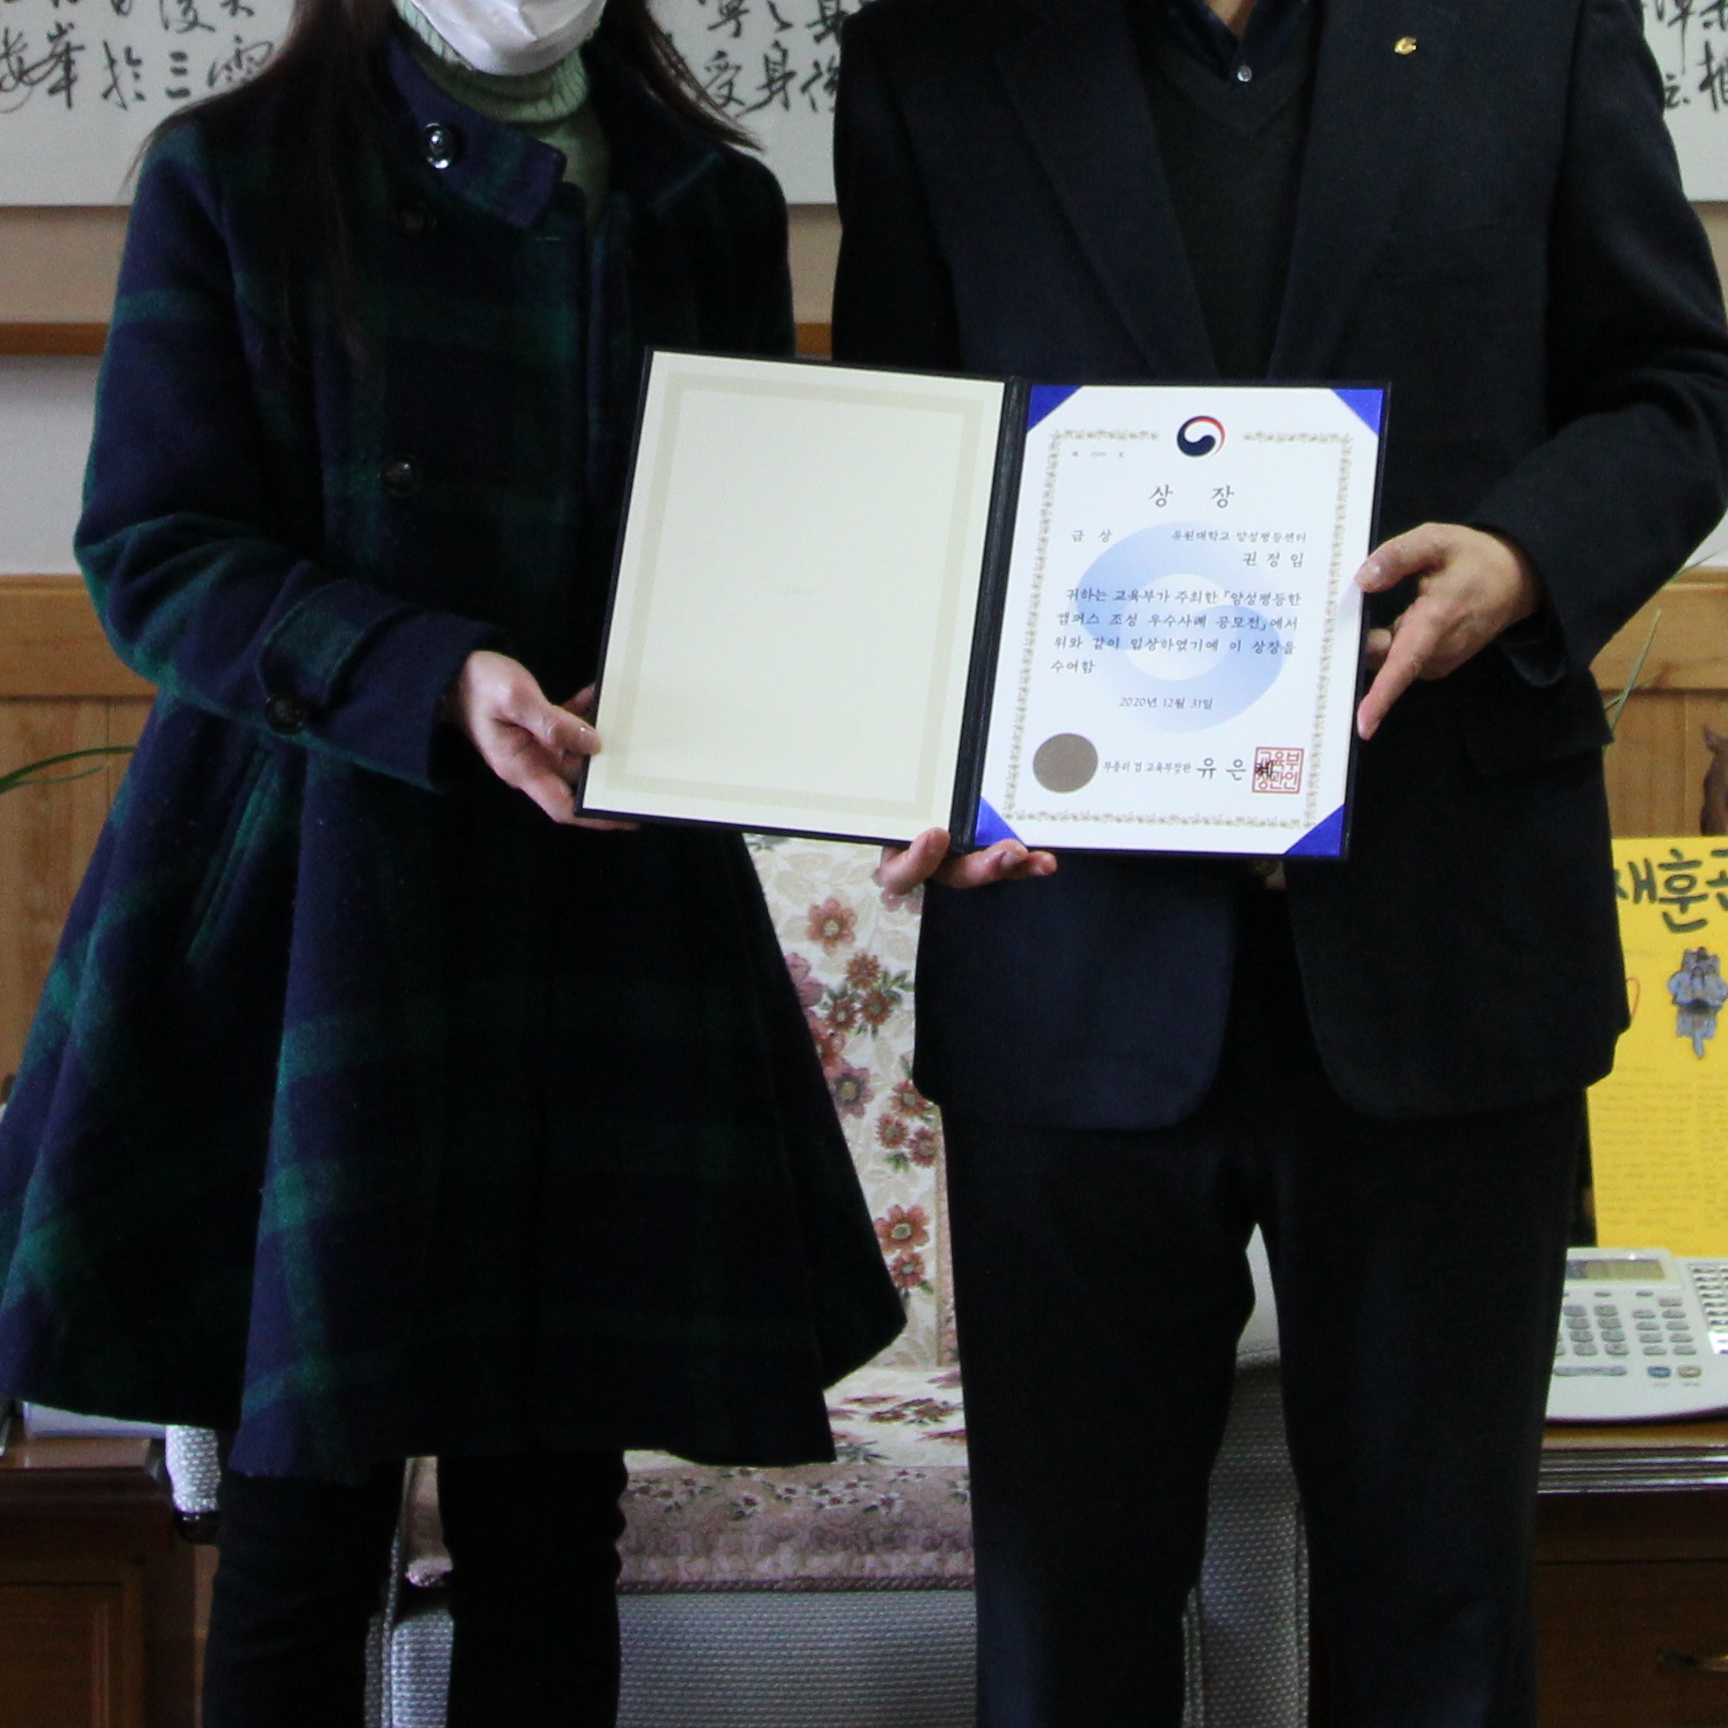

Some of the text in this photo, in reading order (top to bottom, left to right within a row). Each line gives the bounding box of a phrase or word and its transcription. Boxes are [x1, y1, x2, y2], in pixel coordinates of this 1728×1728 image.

[1066, 587, 1109, 602] 귀하는
[1113, 588, 1170, 604] 교육부가
[1175, 589, 1218, 605] 주최한
[1109, 612, 1139, 627] 조성
[1147, 613, 1208, 629] 우수사례
[1053, 635, 1297, 656] 위와 같이 입상하였기에 이 상장을
[1118, 696, 1158, 710] 2020년
[1162, 697, 1186, 711] 12월
